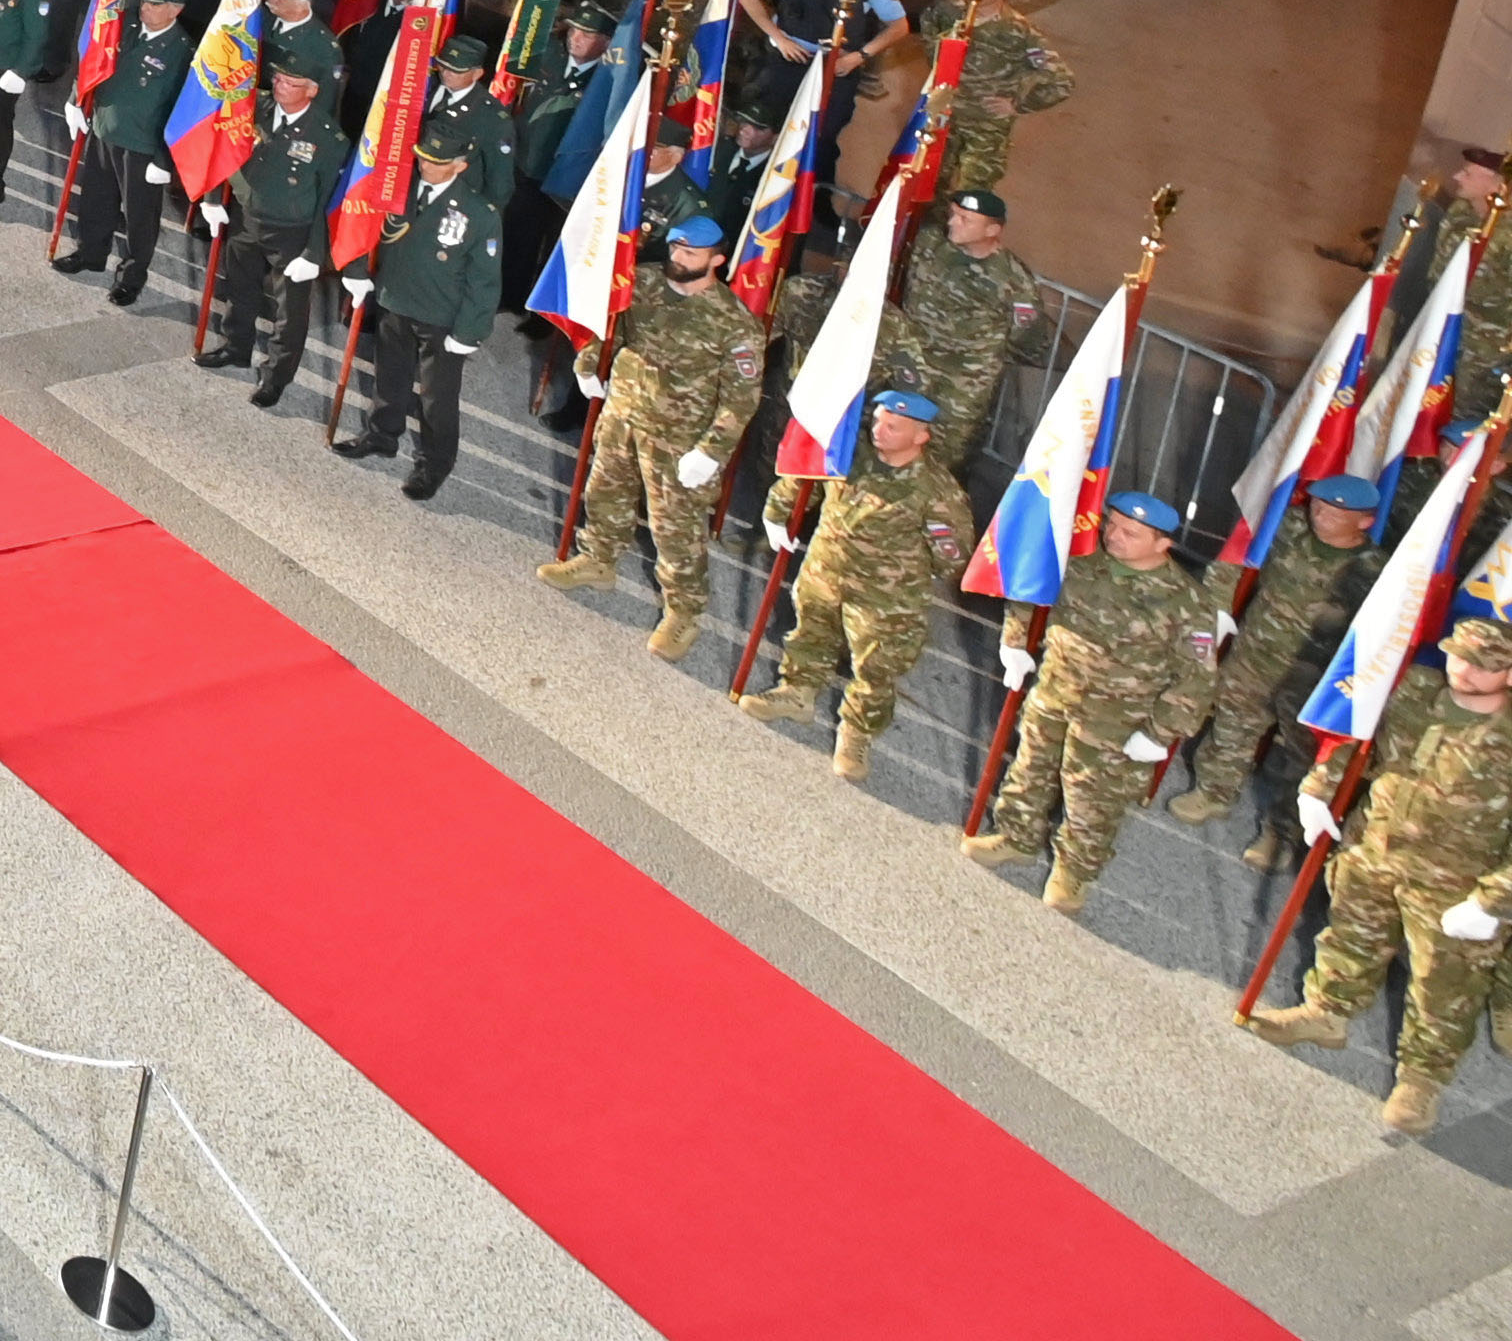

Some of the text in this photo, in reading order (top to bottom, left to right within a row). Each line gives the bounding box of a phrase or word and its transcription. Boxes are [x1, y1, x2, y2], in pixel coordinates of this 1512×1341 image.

[381, 39, 420, 201] GENERALŠTAB SLOVENSKE VOJSKE
